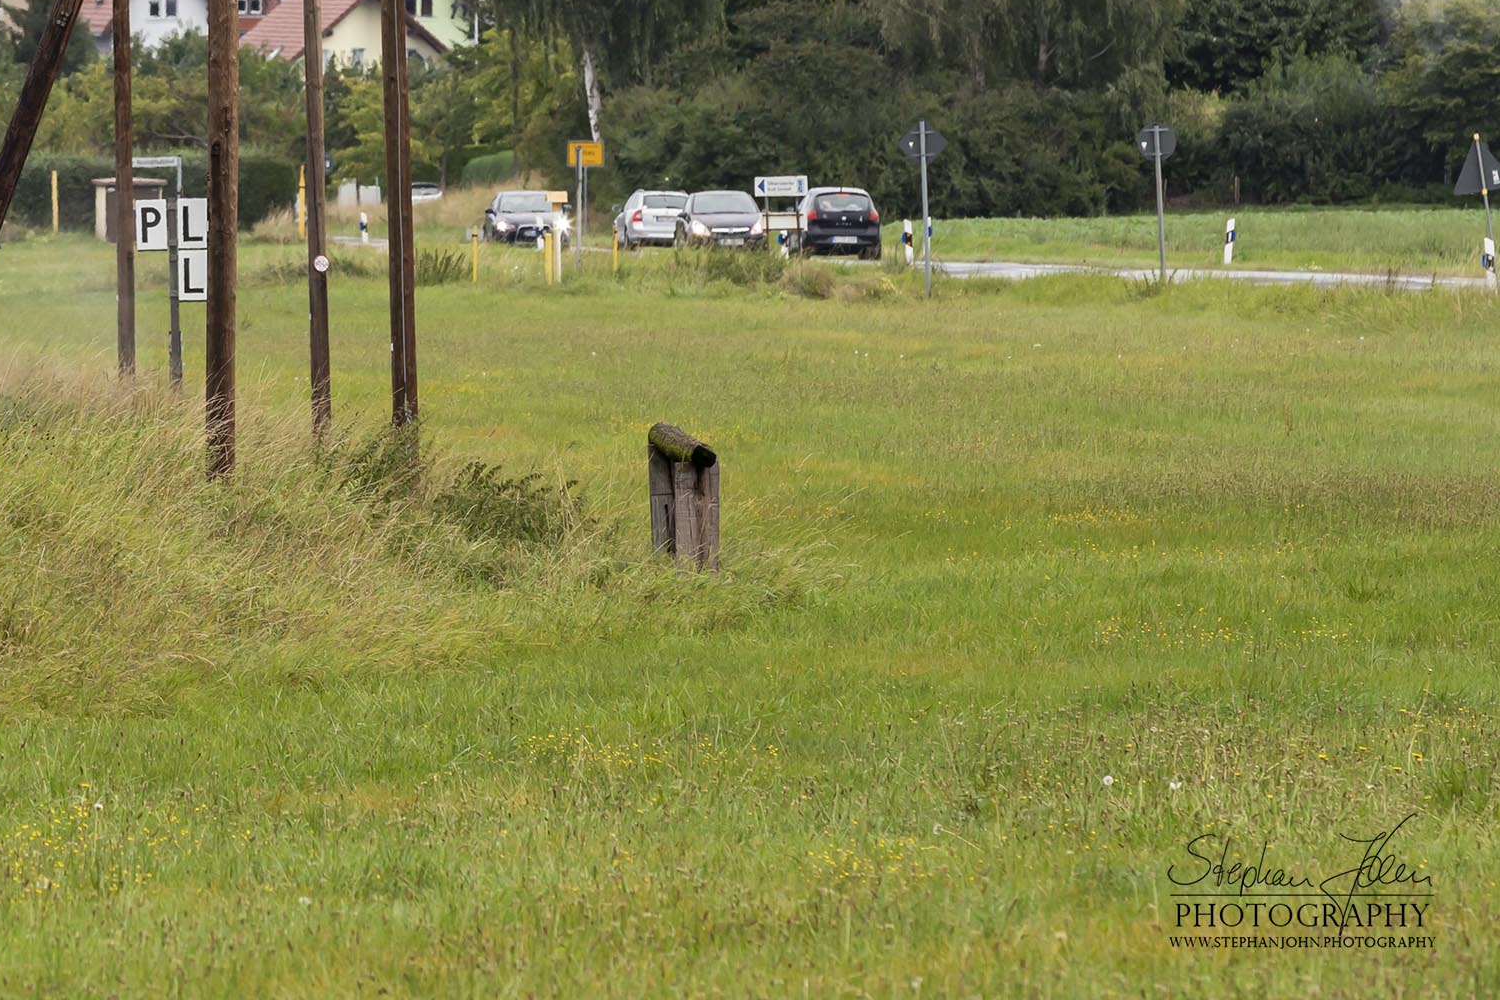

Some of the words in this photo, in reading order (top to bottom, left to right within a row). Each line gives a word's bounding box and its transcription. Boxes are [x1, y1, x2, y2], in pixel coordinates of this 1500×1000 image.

[140, 207, 161, 243] P
[182, 206, 203, 242] L
[183, 258, 204, 293] L
